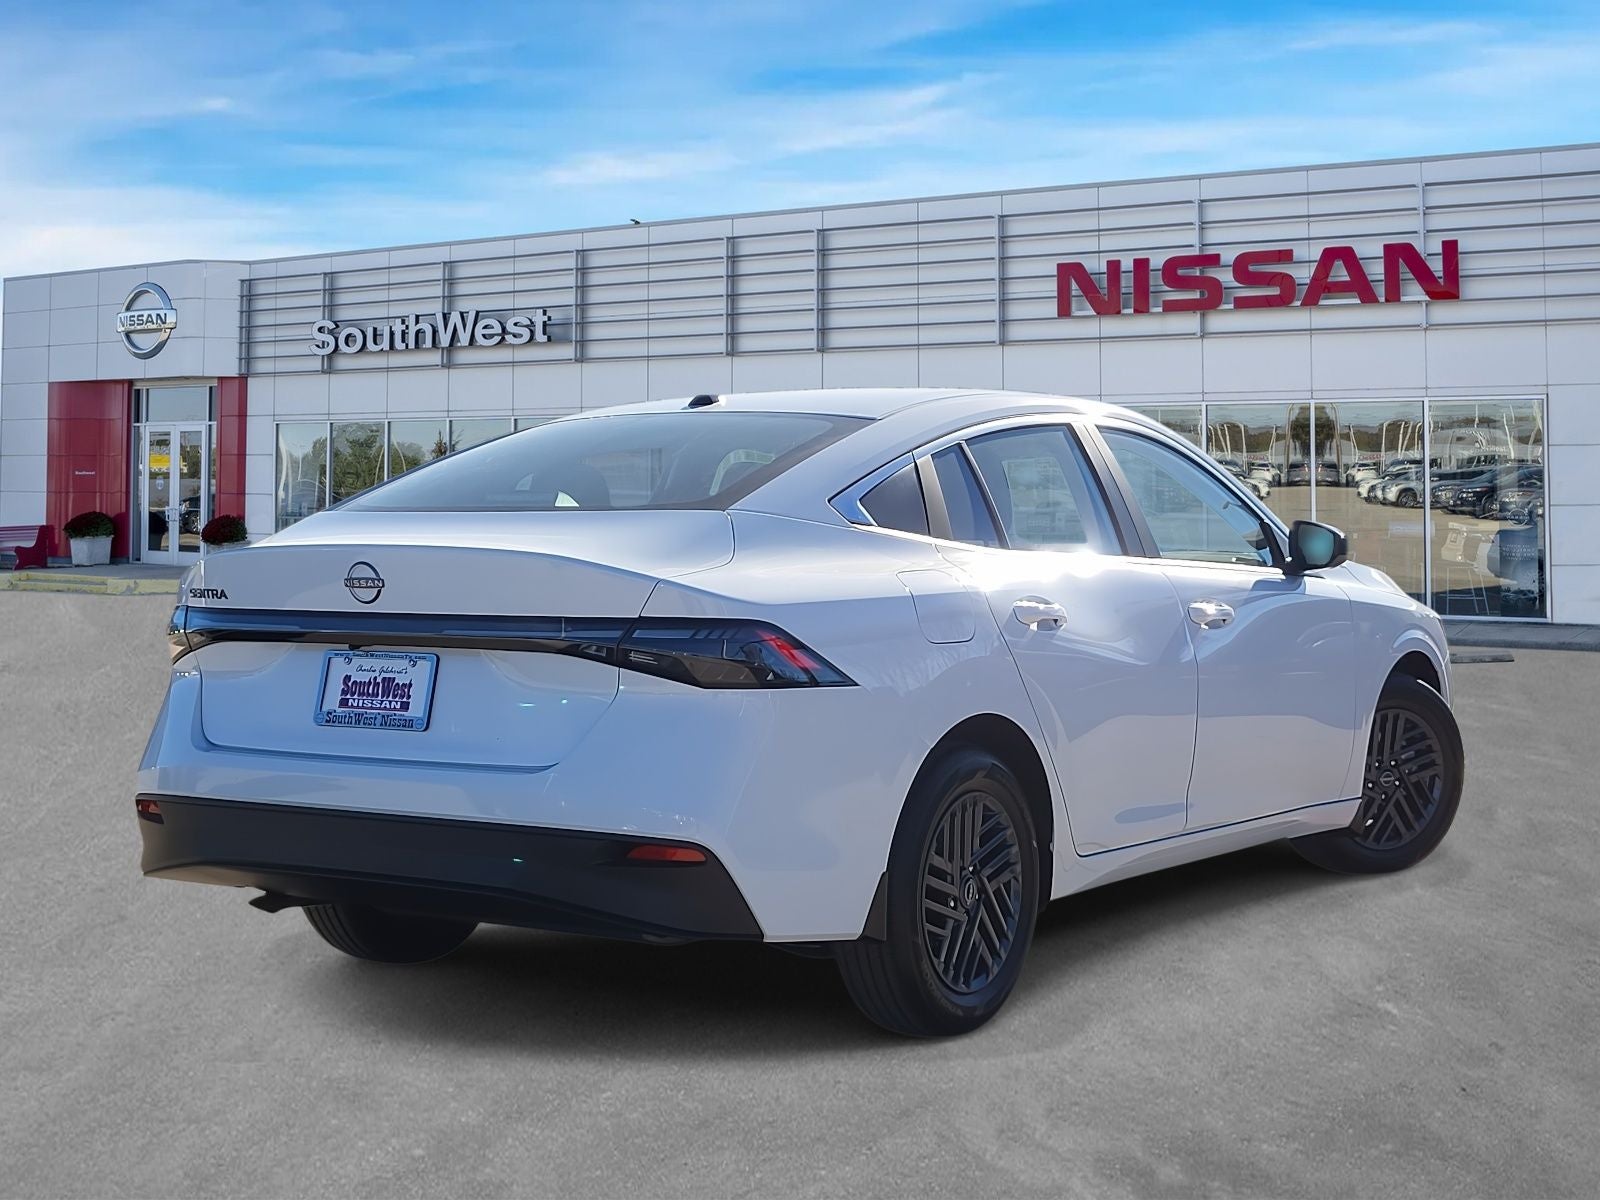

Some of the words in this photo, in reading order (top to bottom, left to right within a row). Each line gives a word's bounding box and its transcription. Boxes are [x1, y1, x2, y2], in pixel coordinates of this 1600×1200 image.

[1056, 239, 1460, 318] NISSAN
[119, 312, 168, 328] NISSAN
[308, 308, 551, 356] SouthWest
[344, 579, 384, 588] NISSAN
[189, 588, 229, 600] SENTRA
[340, 674, 413, 700] SouthWest
[348, 699, 401, 709] NISSAN
[325, 711, 377, 727] SouthWest
[380, 714, 414, 729] Nissan
